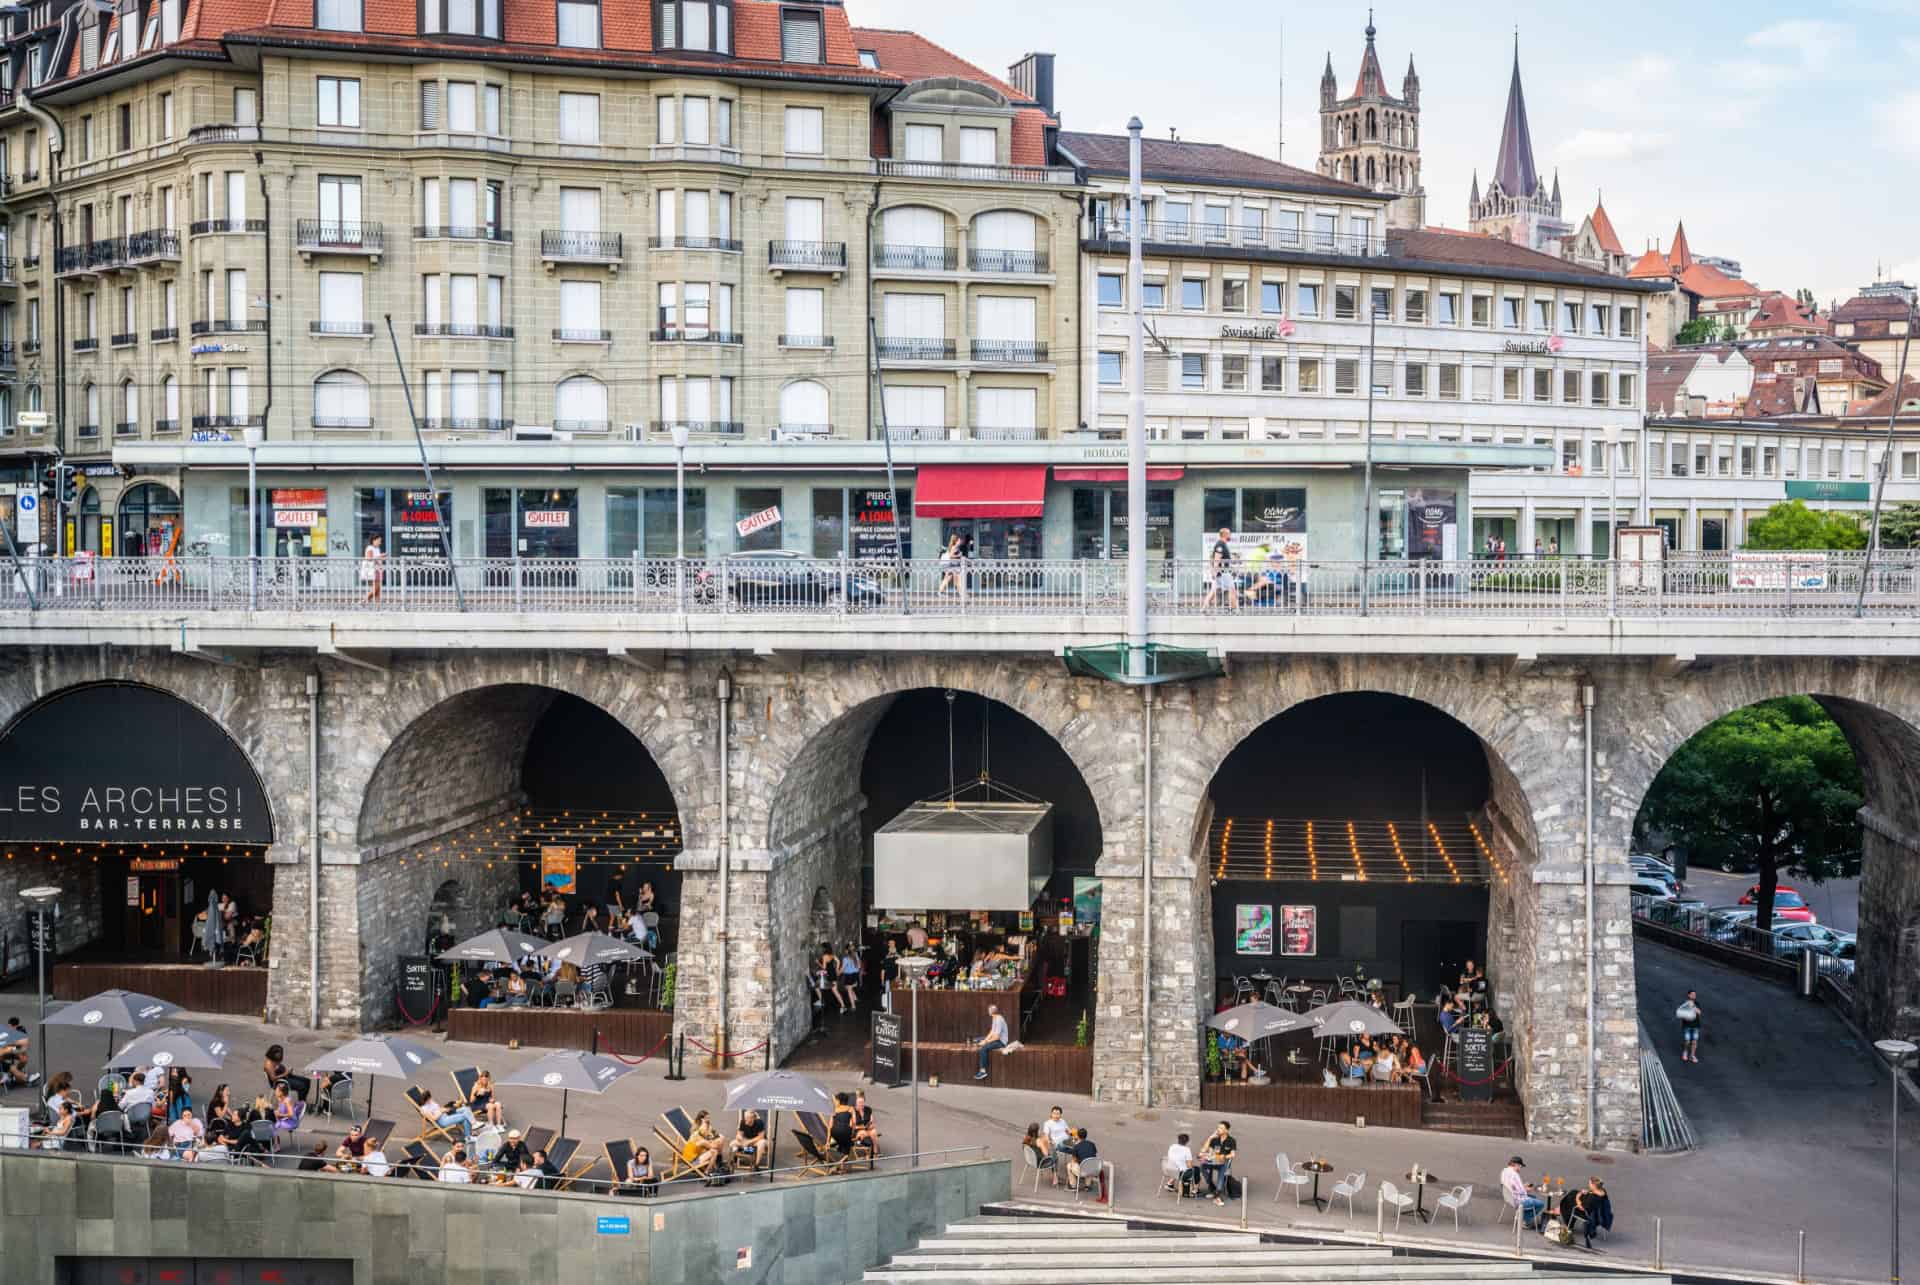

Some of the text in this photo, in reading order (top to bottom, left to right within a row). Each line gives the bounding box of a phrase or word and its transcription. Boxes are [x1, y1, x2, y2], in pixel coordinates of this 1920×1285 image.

[277, 511, 314, 522] OUTLET
[528, 511, 566, 522] OUTLET
[740, 507, 777, 531] OUTLET
[81, 787, 241, 813] ARCHES!
[80, 818, 242, 829] BAR-TERRASSE
